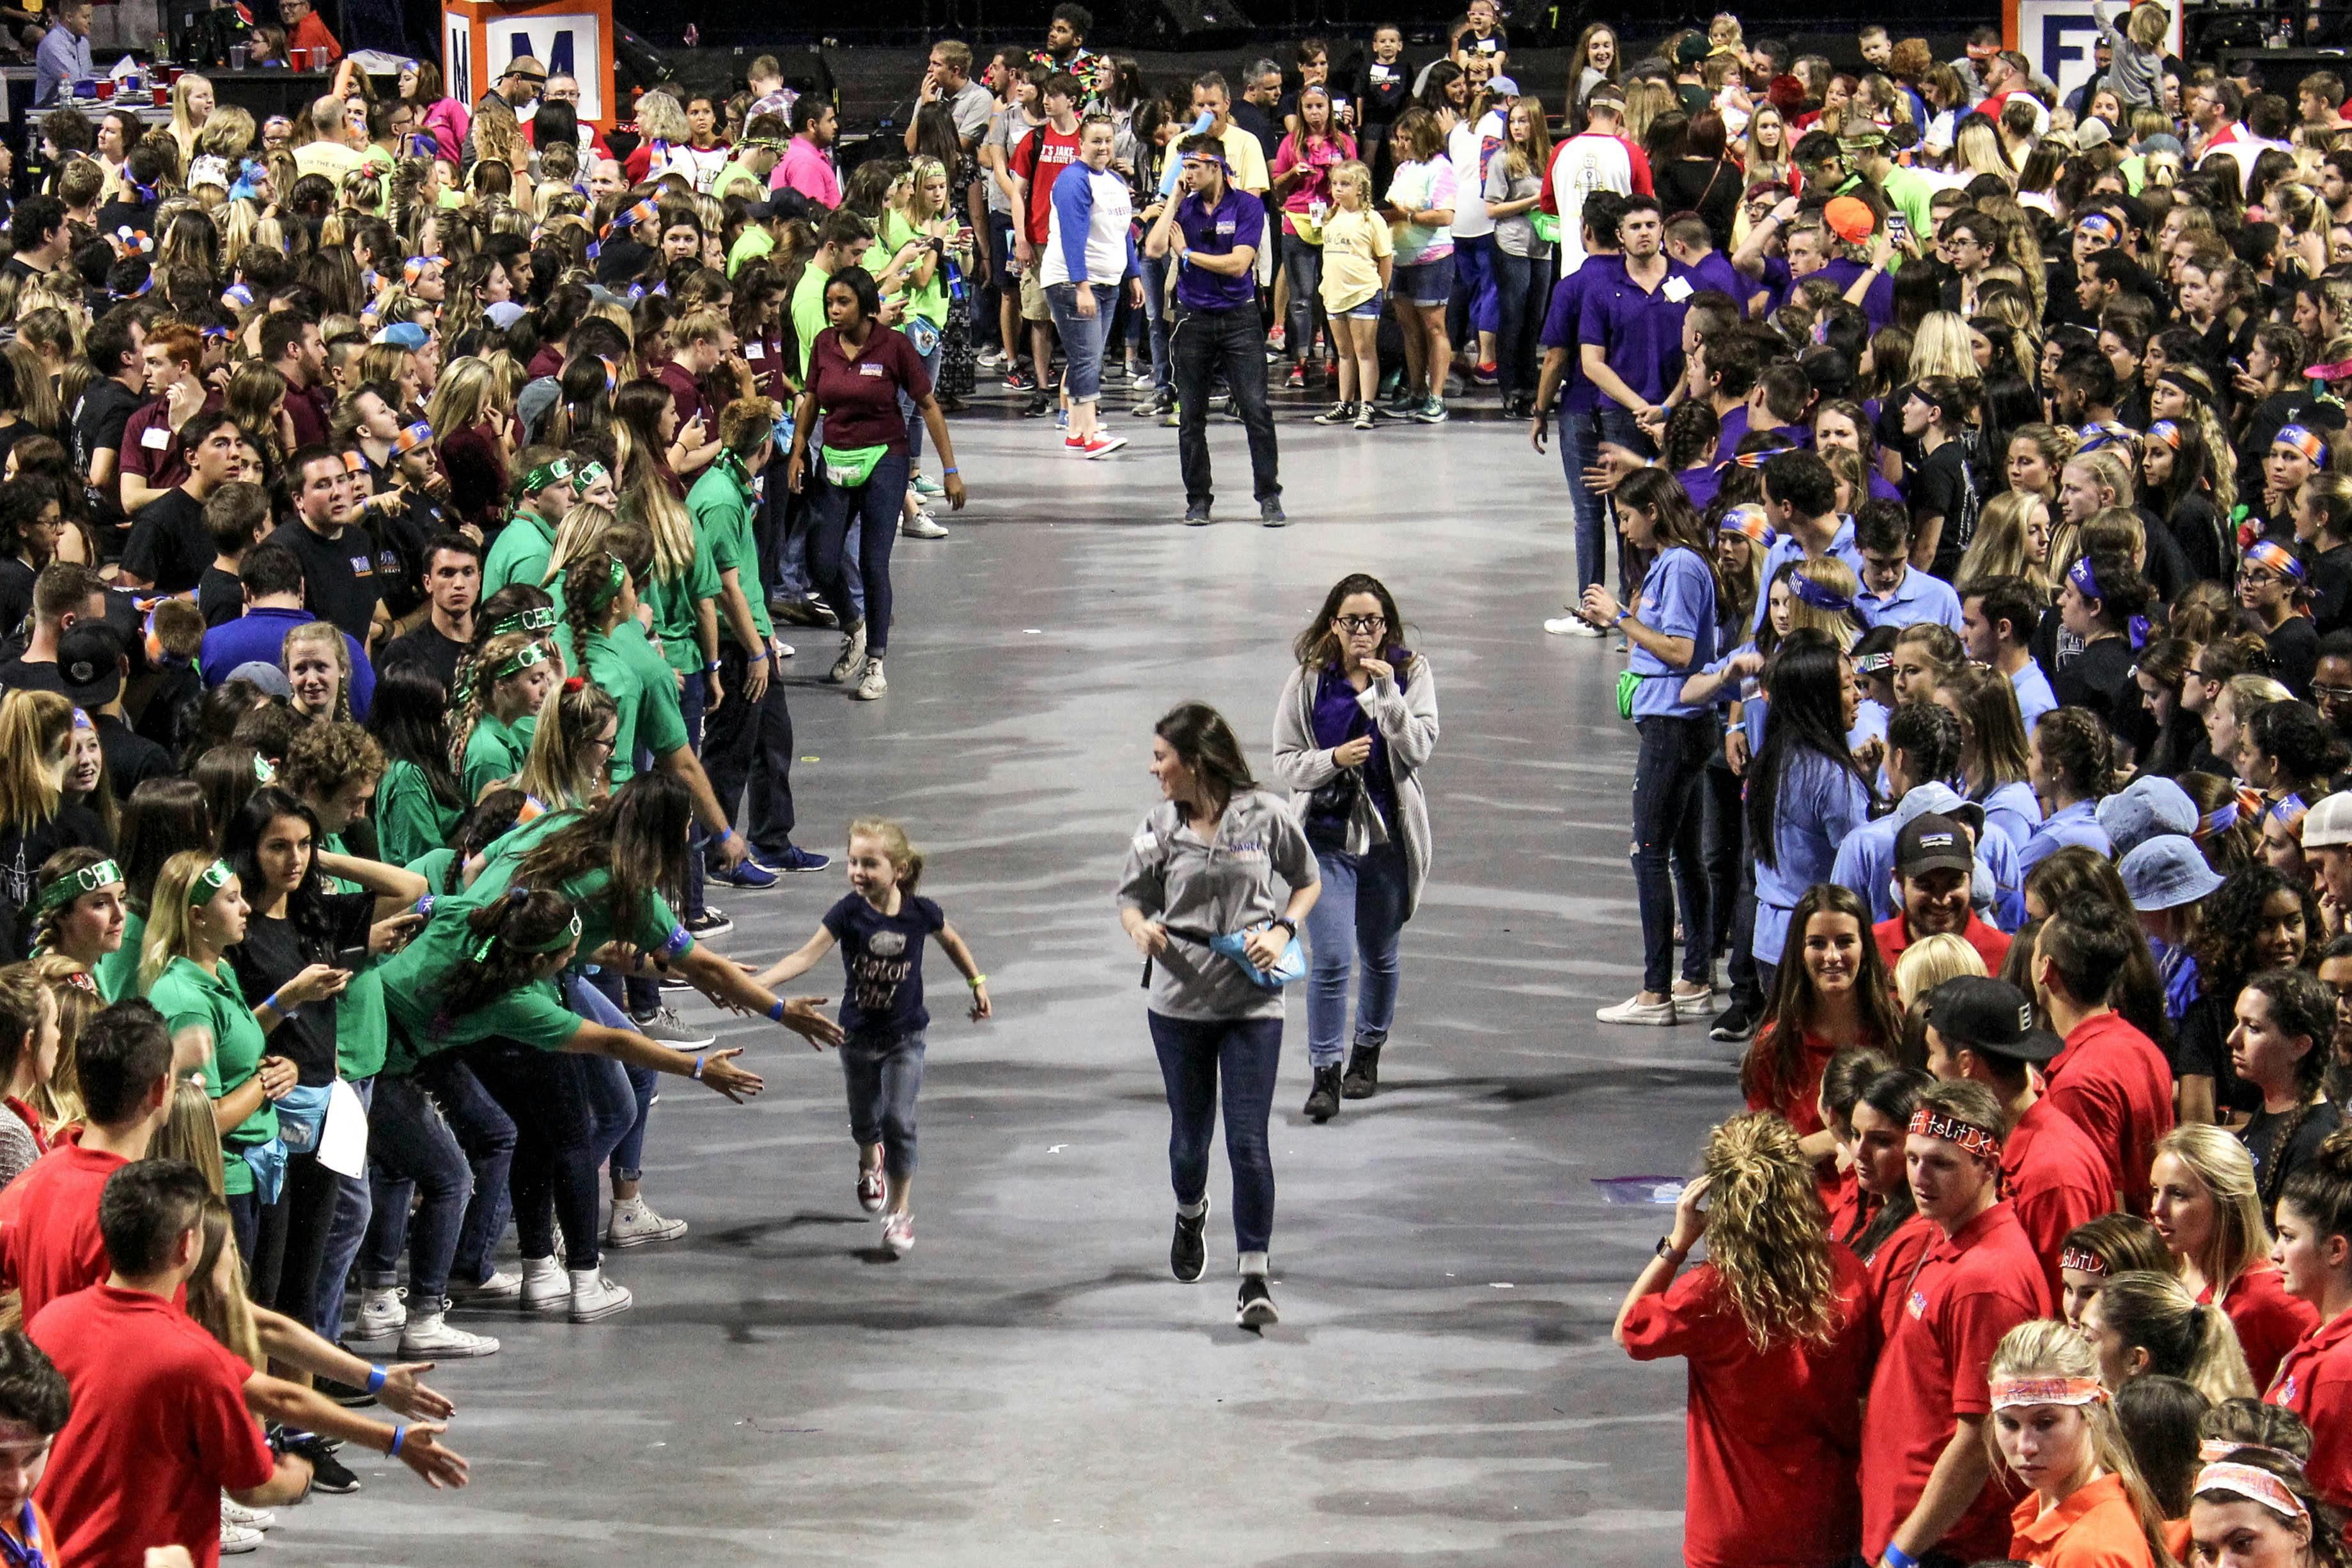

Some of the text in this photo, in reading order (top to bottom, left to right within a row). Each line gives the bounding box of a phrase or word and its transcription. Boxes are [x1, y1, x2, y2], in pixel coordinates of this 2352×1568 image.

[453, 29, 470, 104] M
[2043, 15, 2103, 91] F
[1789, 571, 1803, 595] THIS
